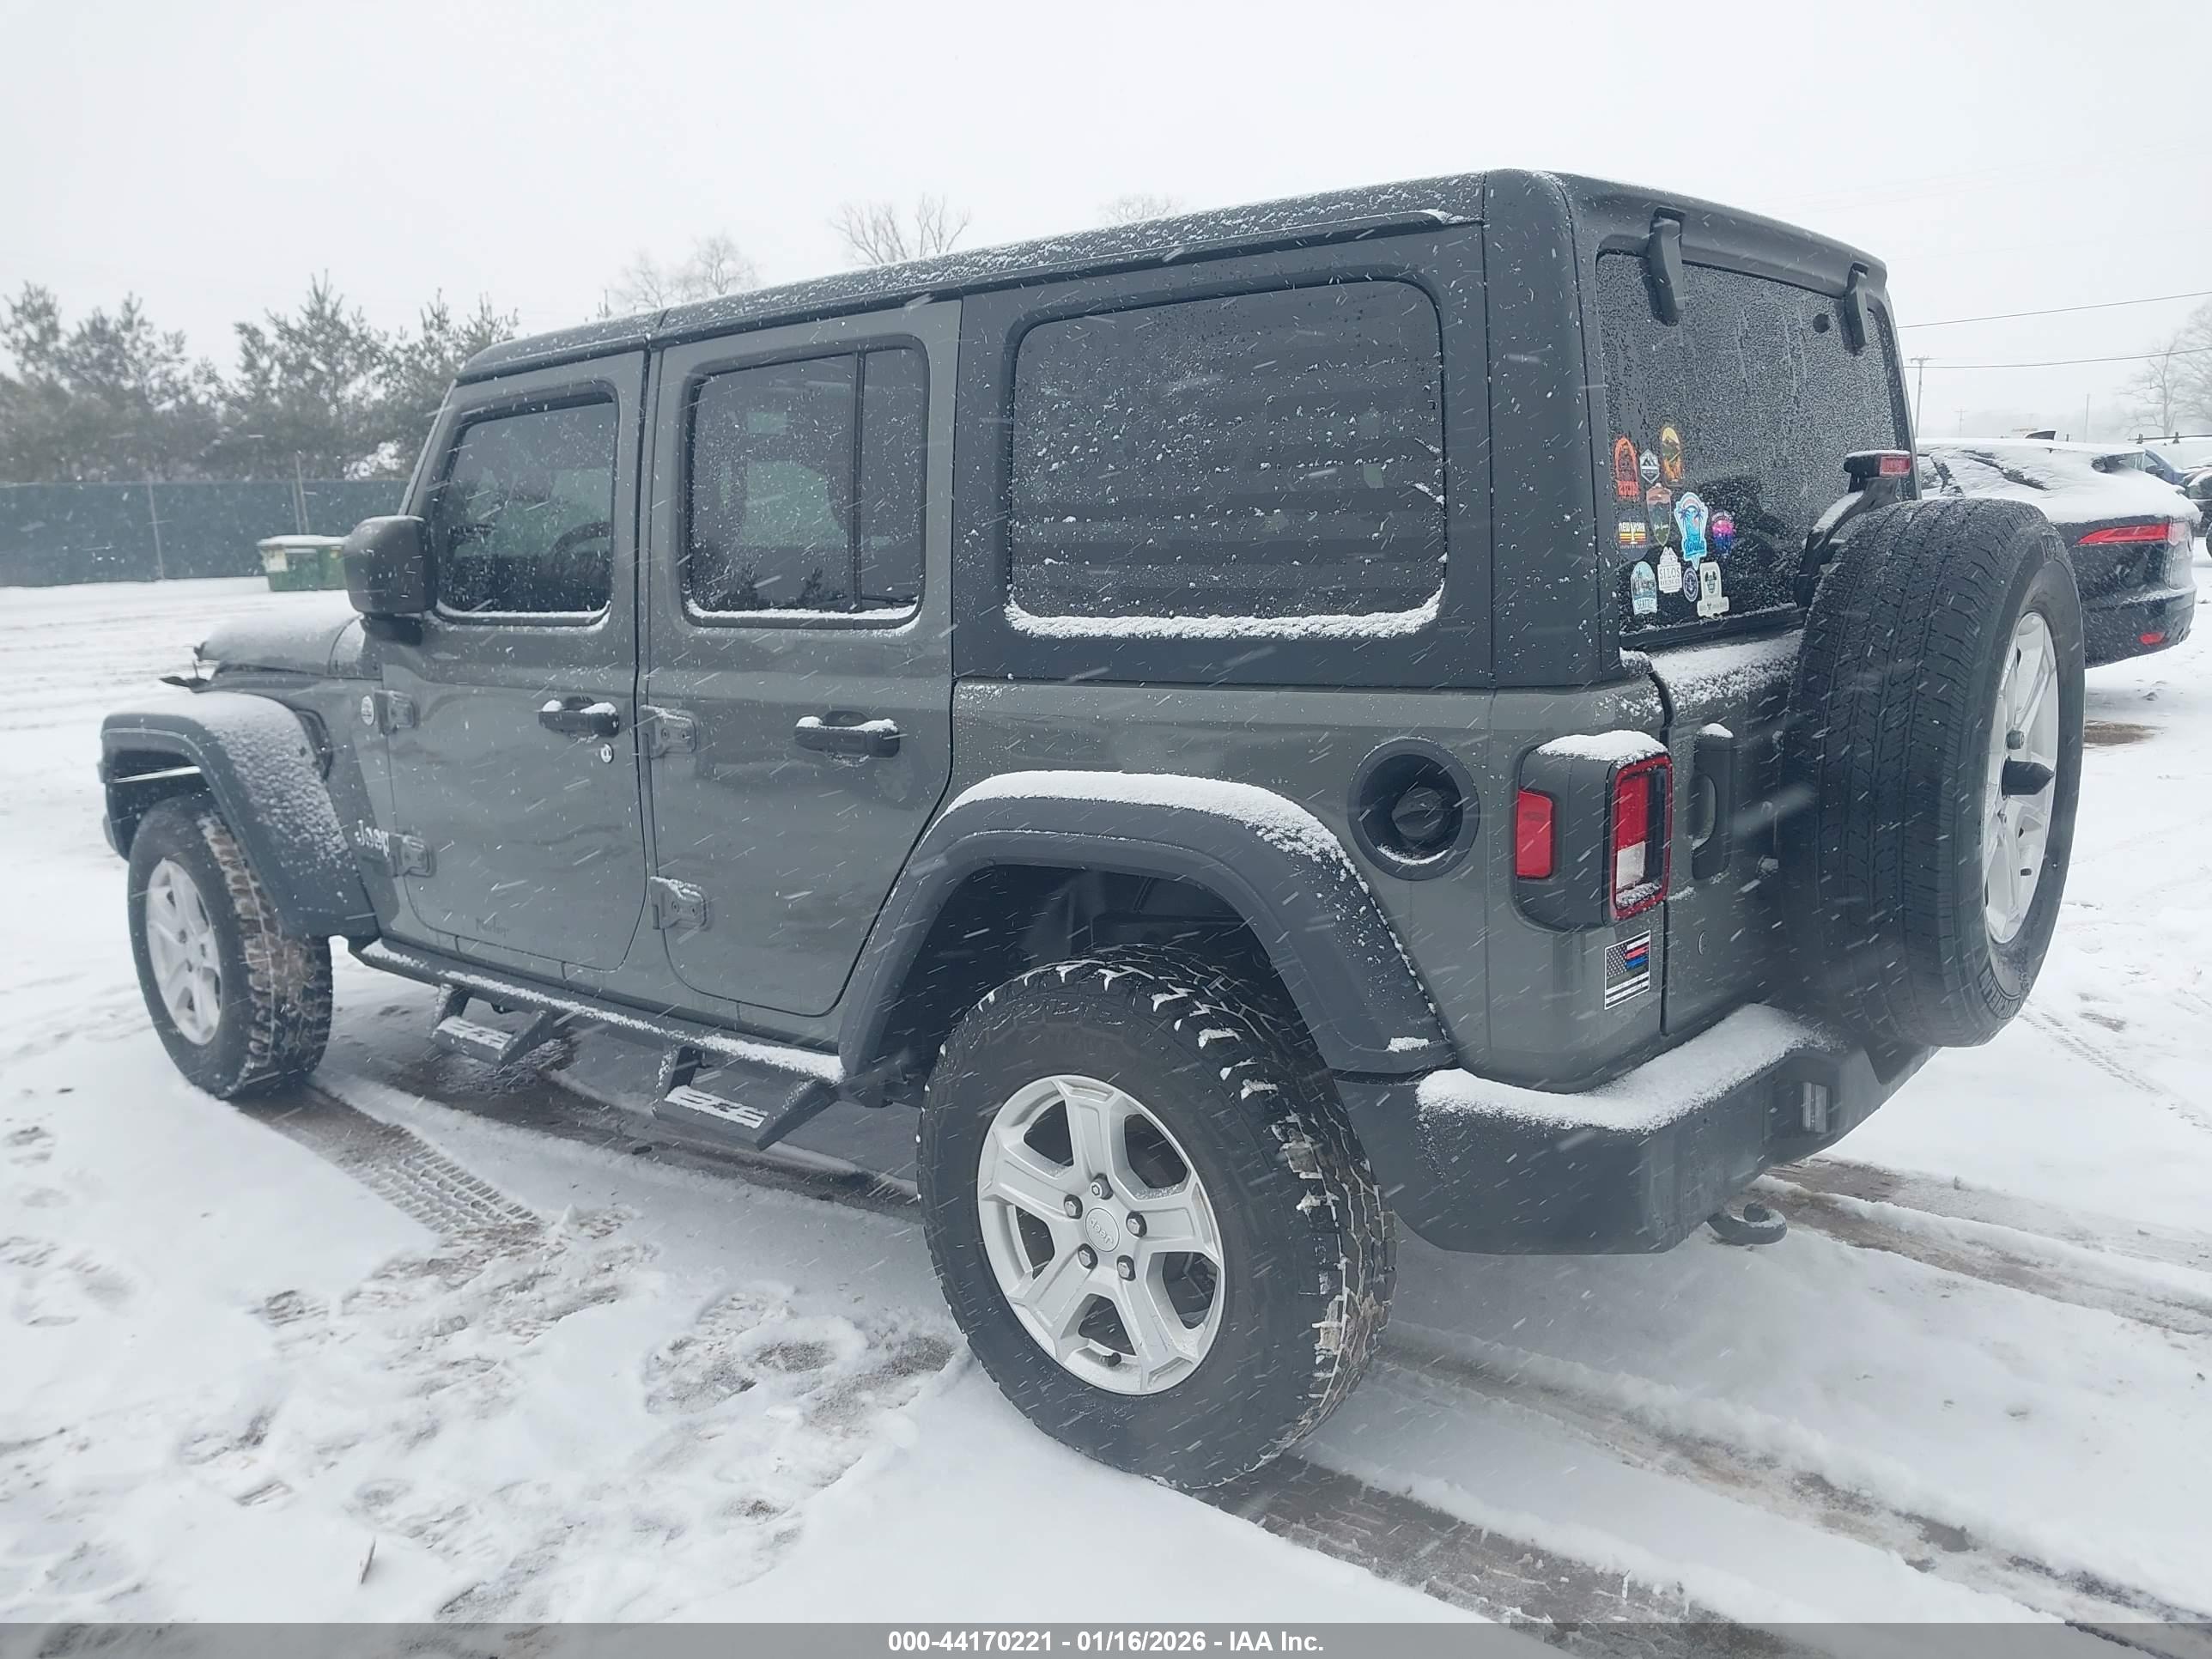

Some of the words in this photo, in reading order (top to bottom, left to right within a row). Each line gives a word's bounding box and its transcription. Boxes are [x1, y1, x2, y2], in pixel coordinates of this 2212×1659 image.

[1659, 567, 1680, 580] SILOS
[354, 819, 391, 858] Jeep
[1090, 1217, 1115, 1244] Jeep
